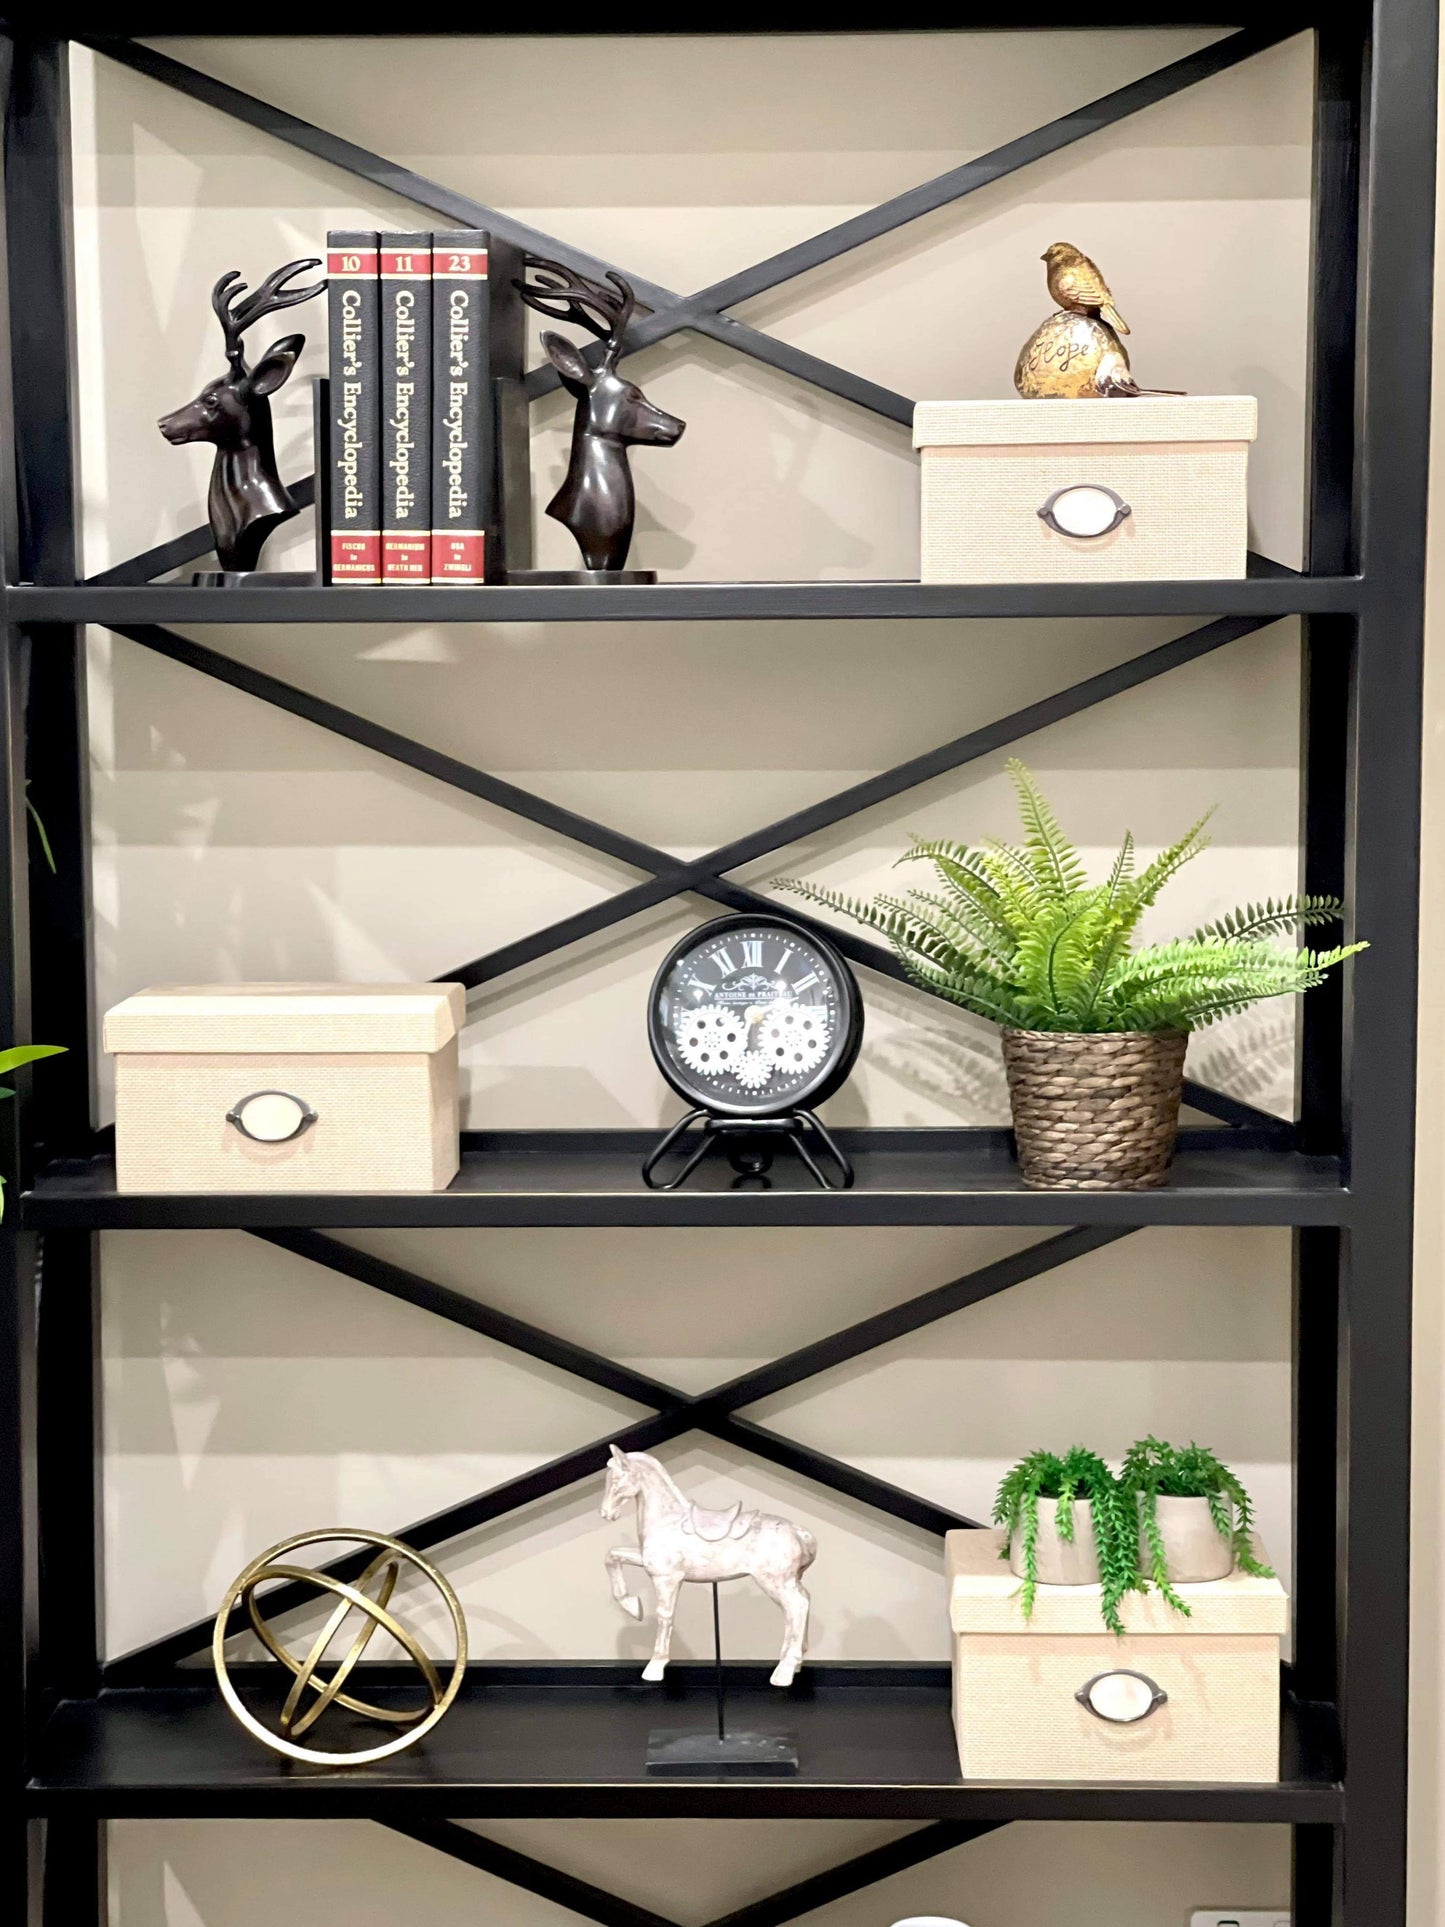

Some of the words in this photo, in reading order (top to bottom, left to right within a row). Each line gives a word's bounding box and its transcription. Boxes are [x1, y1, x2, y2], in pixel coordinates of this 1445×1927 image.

[341, 256, 361, 272] 10
[395, 256, 413, 272] 11
[448, 255, 471, 272] 23
[341, 290, 362, 377] Collier's
[394, 290, 415, 377] Collier's
[449, 290, 469, 377] Collier's
[1028, 340, 1090, 373] Hope
[336, 382, 362, 519] Encyclopedia
[389, 382, 415, 519] Encyclopedia
[442, 382, 468, 519] Encyclopedia
[453, 553, 462, 561] to
